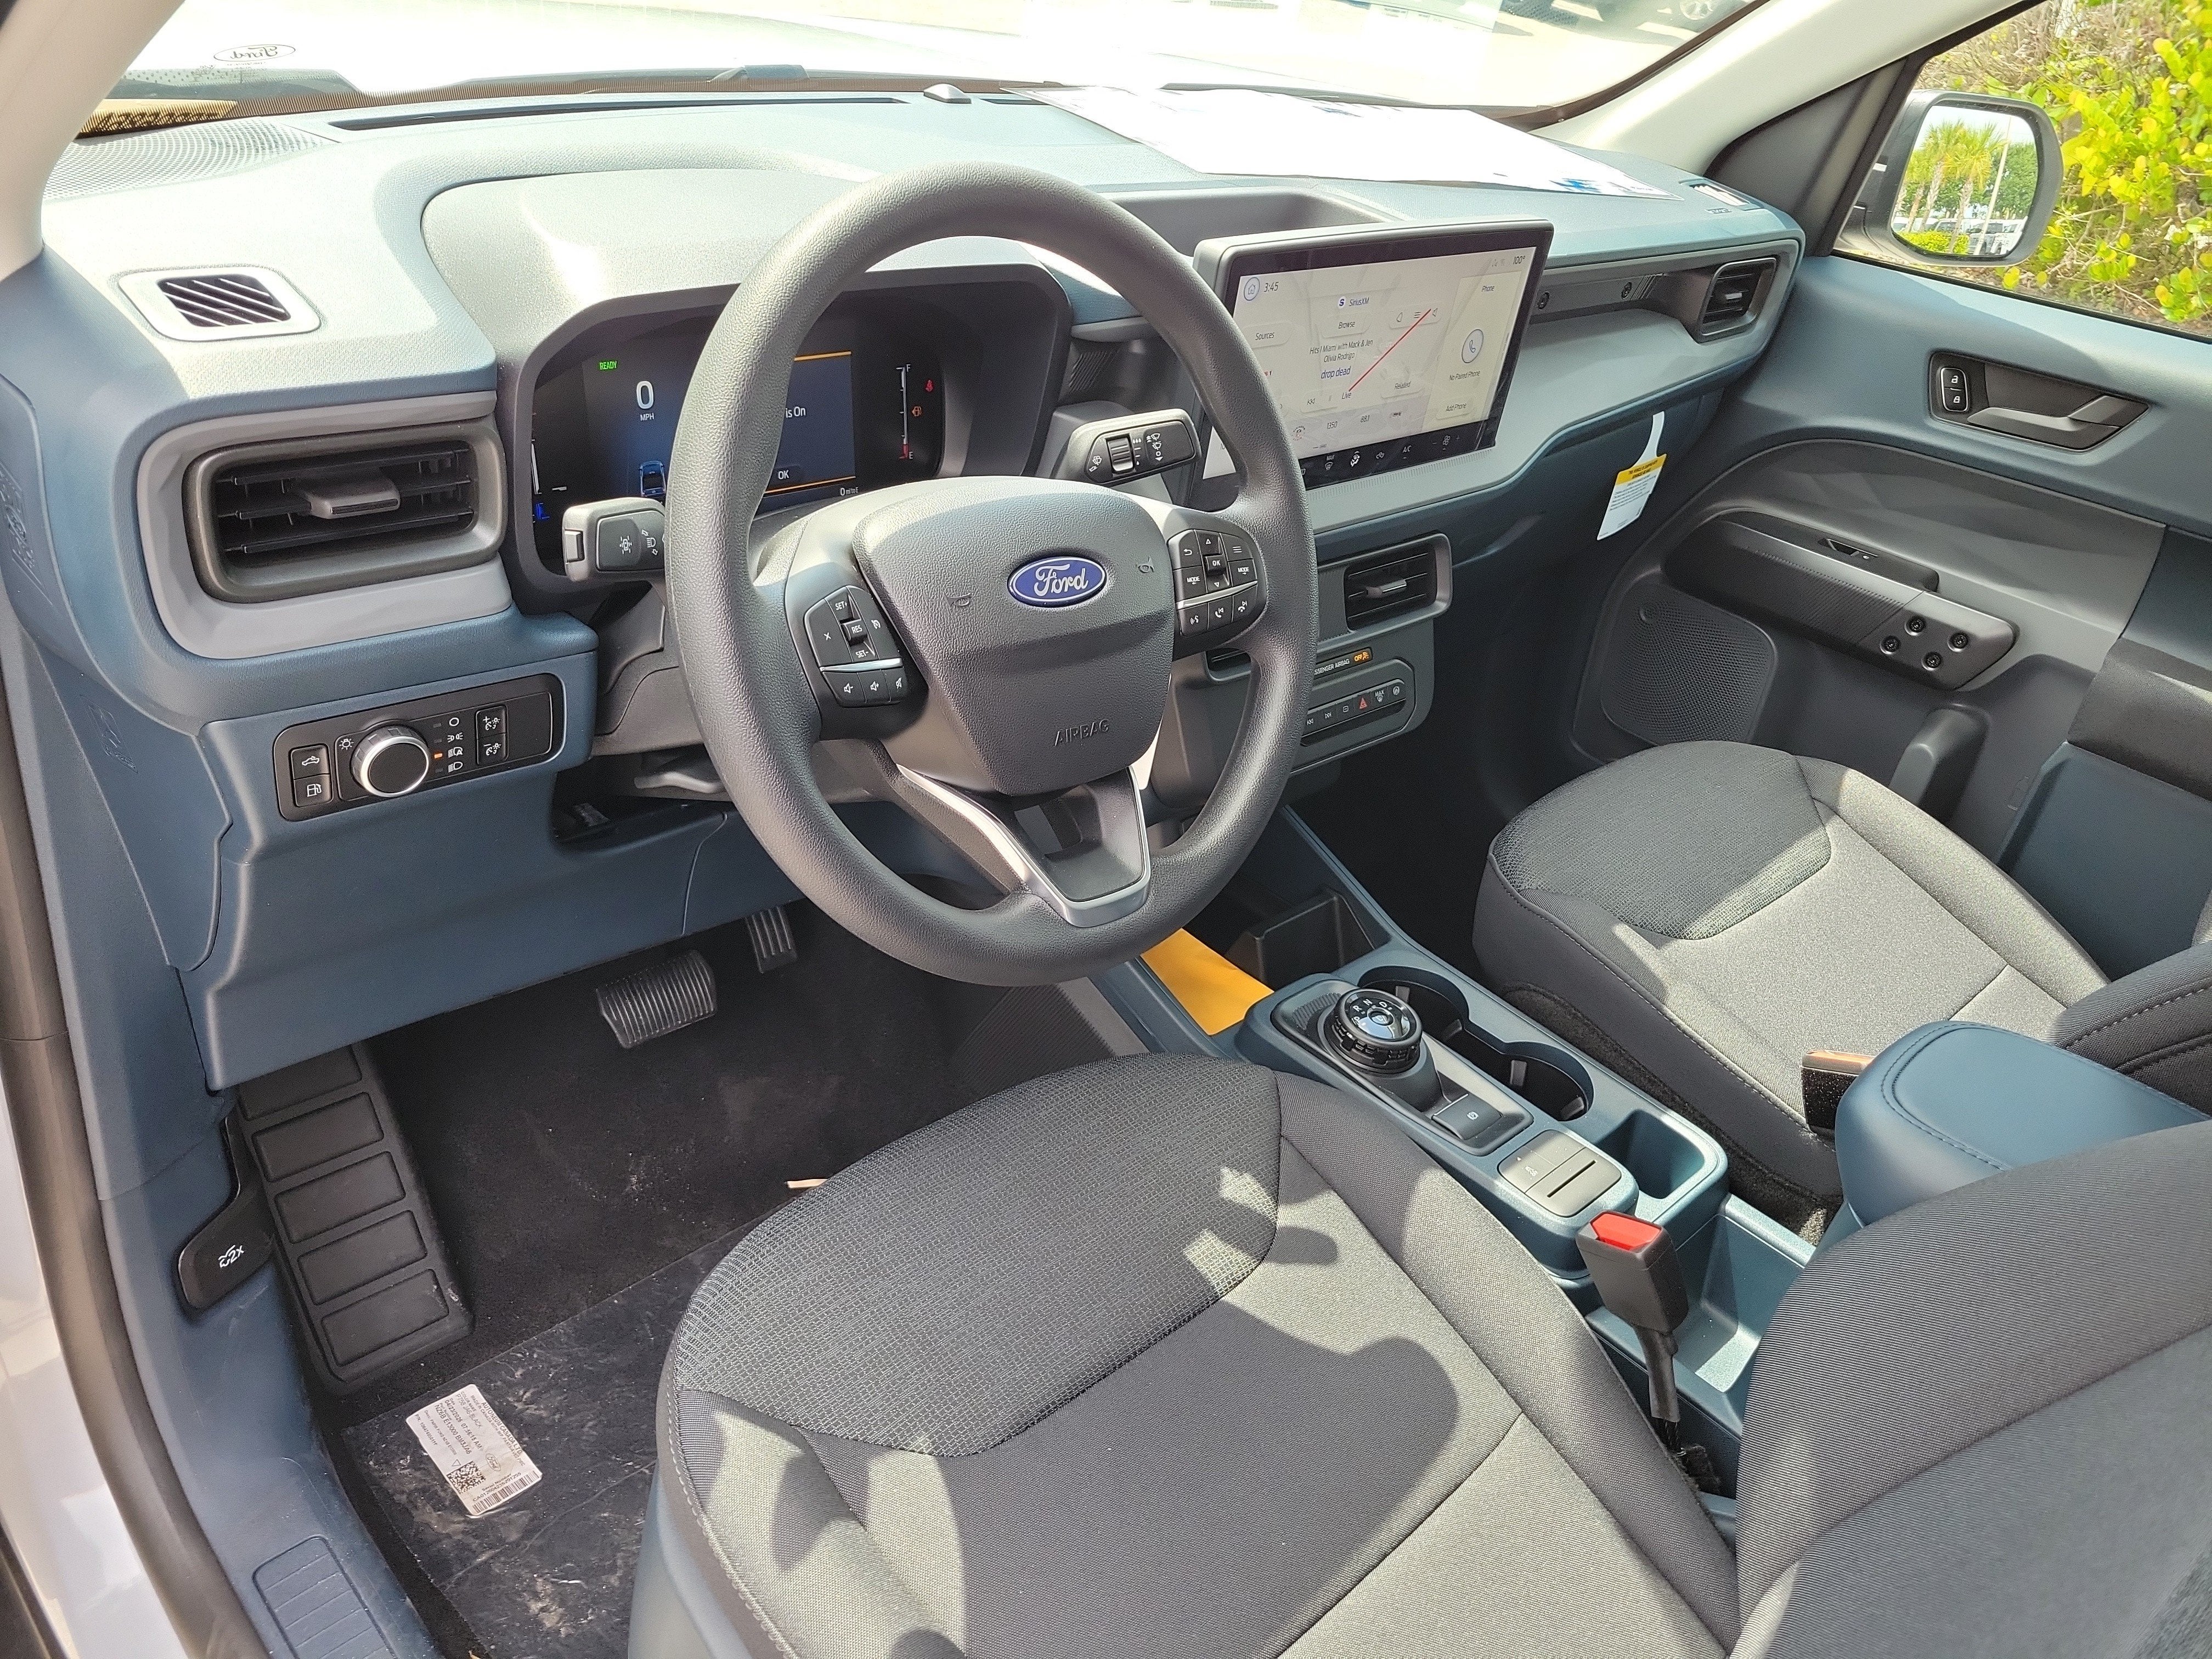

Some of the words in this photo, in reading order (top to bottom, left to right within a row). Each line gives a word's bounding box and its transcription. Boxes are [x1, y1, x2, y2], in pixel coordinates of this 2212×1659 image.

[1263, 281, 1279, 292] 3:45
[1349, 297, 1369, 307] SiriusXM
[1338, 320, 1356, 329] Browse
[1255, 331, 1275, 341] Sources
[1309, 346, 1319, 354] Hits
[1338, 342, 1348, 351] with
[1348, 340, 1361, 348] Mack
[1337, 352, 1355, 360] Rodrigo
[599, 360, 617, 370] READY
[906, 364, 911, 373] F
[1321, 369, 1335, 380] drop
[1335, 365, 1351, 377] dead
[1455, 372, 1468, 380] Paired
[1468, 370, 1481, 379] Phone
[1394, 381, 1411, 390] Related
[636, 380, 654, 409] 0
[1341, 391, 1352, 399] Live
[1456, 402, 1467, 410] Phone
[640, 413, 654, 421] MPH
[786, 408, 793, 418] is
[794, 406, 806, 417] On
[1327, 421, 1338, 430] 1350
[778, 470, 789, 479] OK
[1034, 563, 1089, 596] Ford
[835, 601, 848, 611] SET+
[851, 624, 862, 634] RES
[855, 650, 869, 658] SET-
[1335, 658, 1350, 668] AIRBAG
[1054, 718, 1109, 747] AIRBAG
[471, 1395, 479, 1405] MADE
[481, 1409, 493, 1423] CANADA
[435, 1405, 446, 1419] NZ6B
[444, 1419, 458, 1436] E13000
[481, 1402, 502, 1426] AUTONEUM
[500, 1425, 516, 1444] CANADA
[474, 1441, 482, 1449] AM
[487, 1455, 500, 1470] Ford
